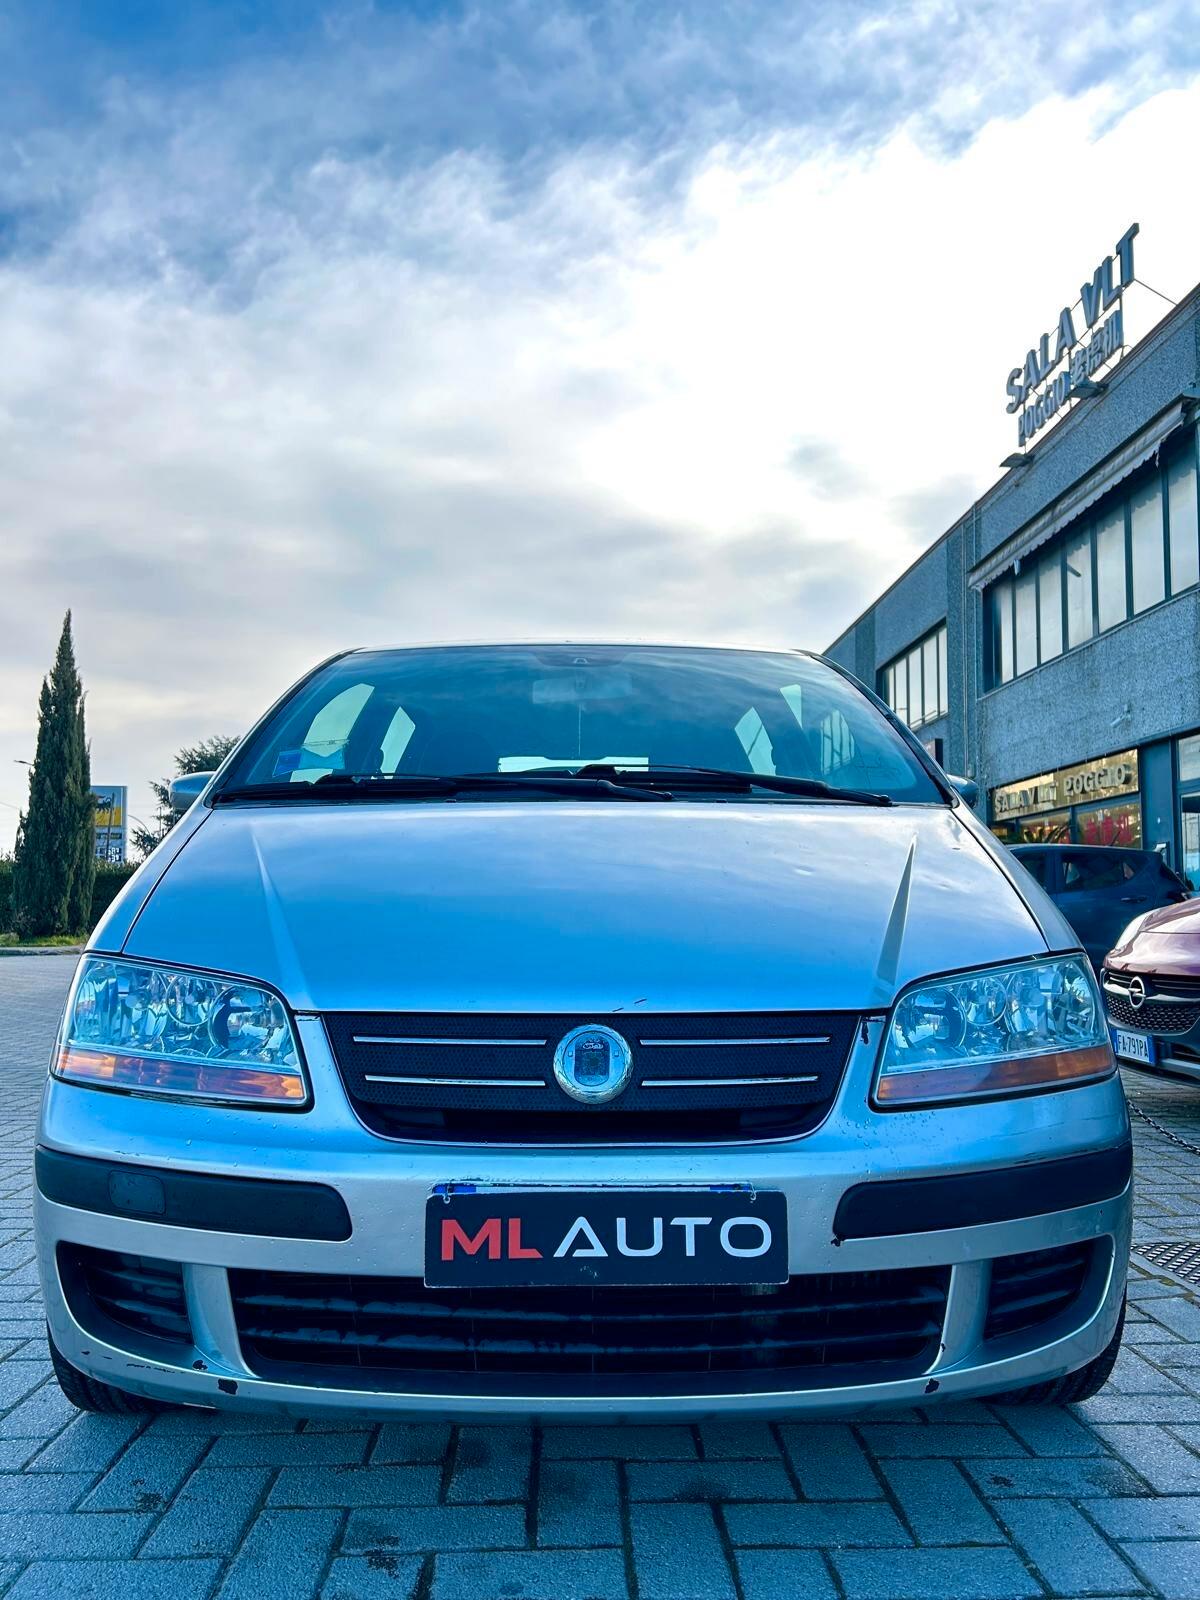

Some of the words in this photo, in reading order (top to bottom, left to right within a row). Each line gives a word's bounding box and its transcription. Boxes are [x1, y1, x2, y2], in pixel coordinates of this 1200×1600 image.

[1006, 307, 1077, 414] SALA
[1080, 223, 1140, 329] VLT
[1018, 371, 1071, 447] POGGIO
[995, 790, 1027, 813] SALA
[1063, 764, 1127, 797] POGGIO
[441, 1217, 543, 1261] ML
[552, 1215, 773, 1259] AUTO
